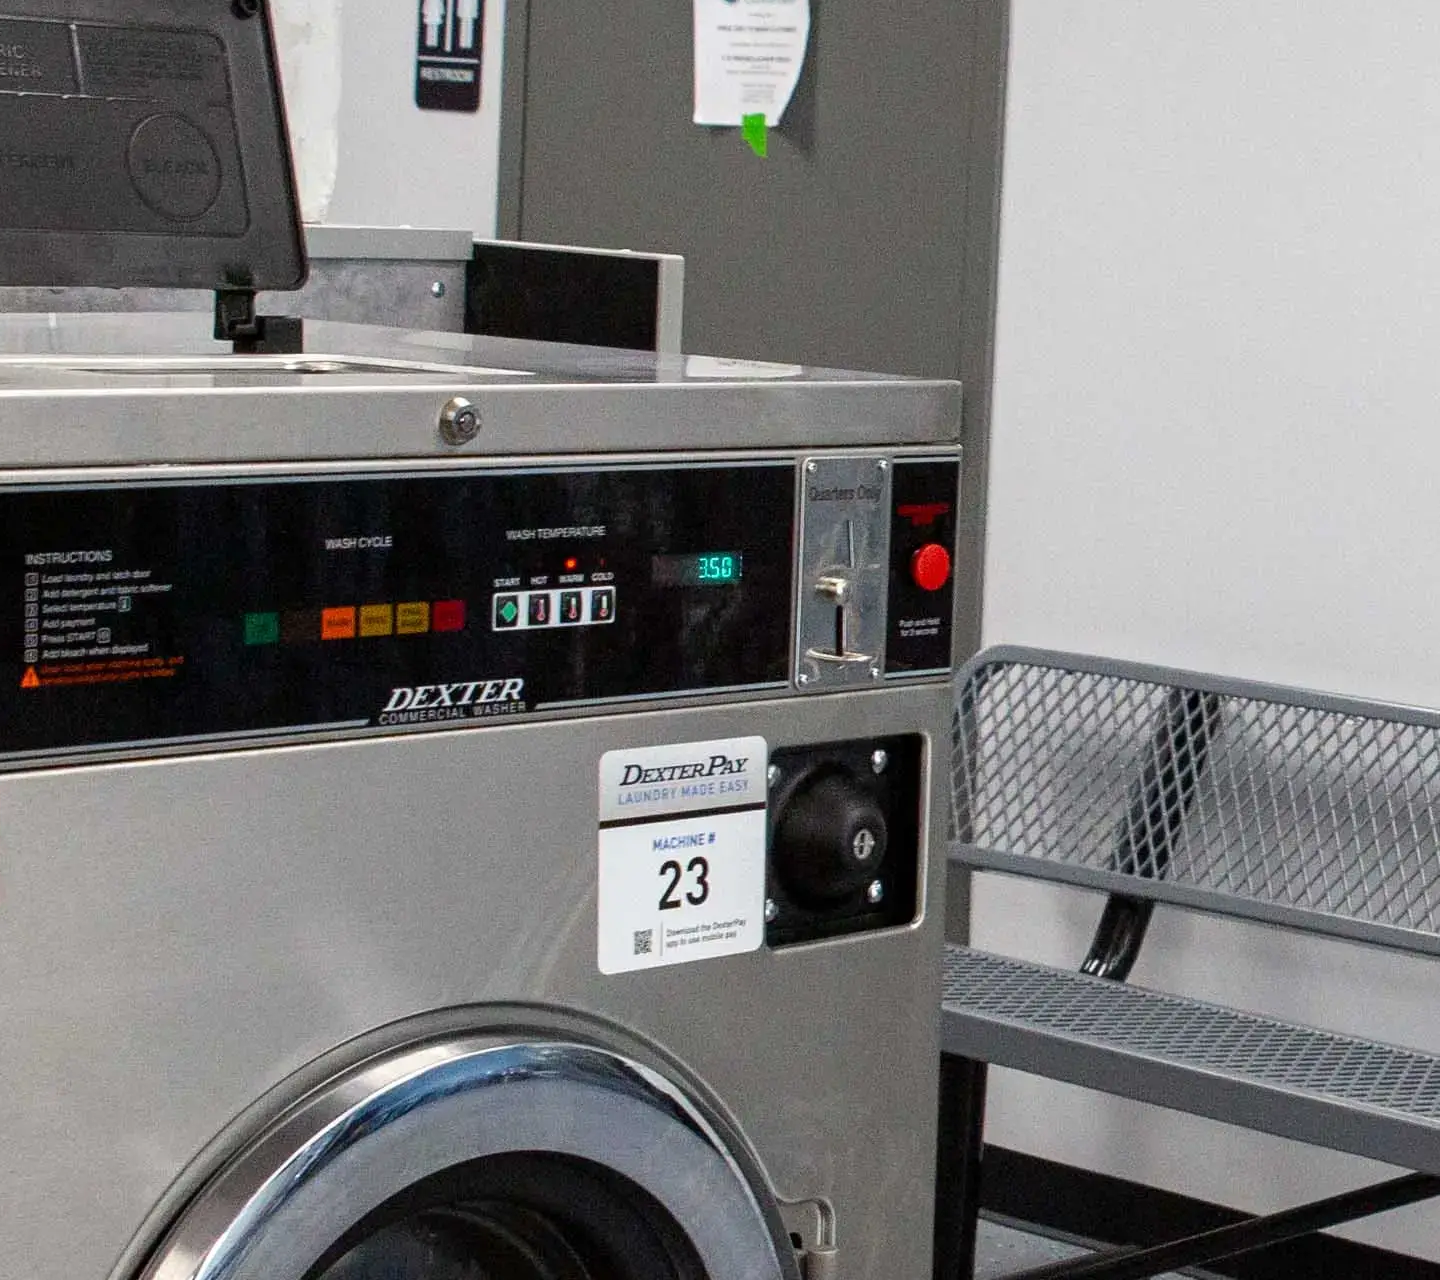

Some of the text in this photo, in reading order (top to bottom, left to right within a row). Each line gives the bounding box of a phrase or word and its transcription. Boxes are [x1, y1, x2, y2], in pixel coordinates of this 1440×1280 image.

[506, 526, 607, 540] WASH TEMPERATURE
[326, 535, 392, 550] WASH CYCLE
[25, 550, 113, 565] INSTRUCTIONS
[494, 578, 520, 587] START
[531, 576, 548, 585] HOT
[592, 572, 614, 581] COLD
[383, 679, 523, 712] DEXTER
[379, 702, 526, 726] COMMERCIAL WASHER
[618, 779, 749, 806] LAUNDRY MADE EASY
[653, 832, 716, 852] MACHINE #
[659, 856, 709, 911] 23
